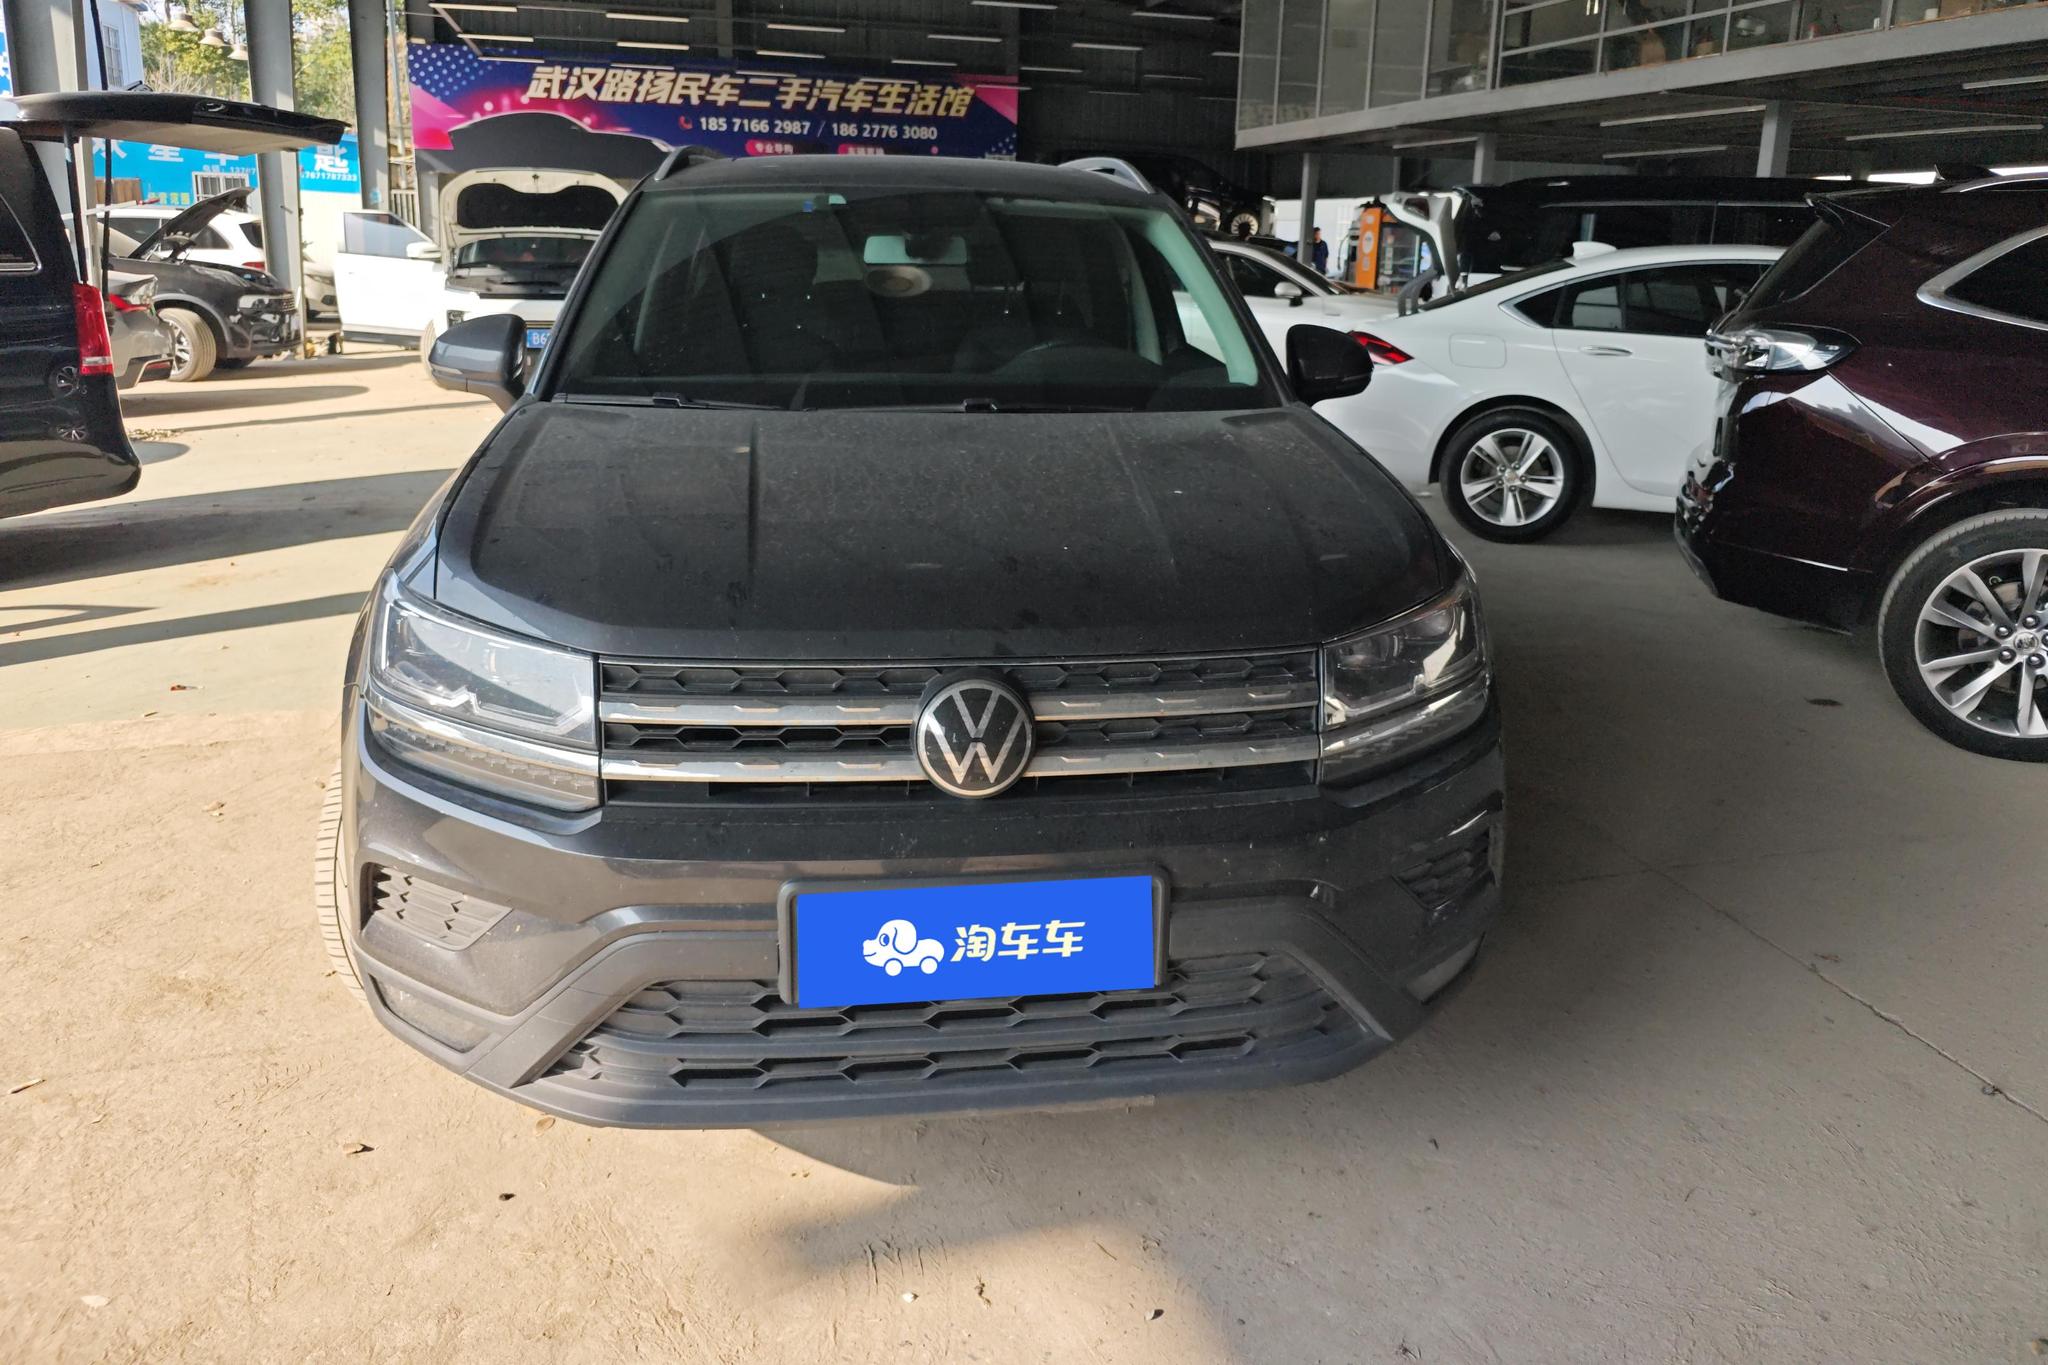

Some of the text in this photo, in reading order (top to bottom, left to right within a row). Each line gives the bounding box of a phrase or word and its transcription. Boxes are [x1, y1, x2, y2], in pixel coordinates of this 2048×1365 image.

[525, 65, 975, 118] 武汉路扬民车二手汽车生活馆
[700, 117, 728, 132] 185
[732, 118, 770, 133] 7166
[773, 119, 811, 135] 2987
[831, 122, 858, 137] 186
[862, 124, 898, 139] 2776
[902, 125, 938, 140] 3080
